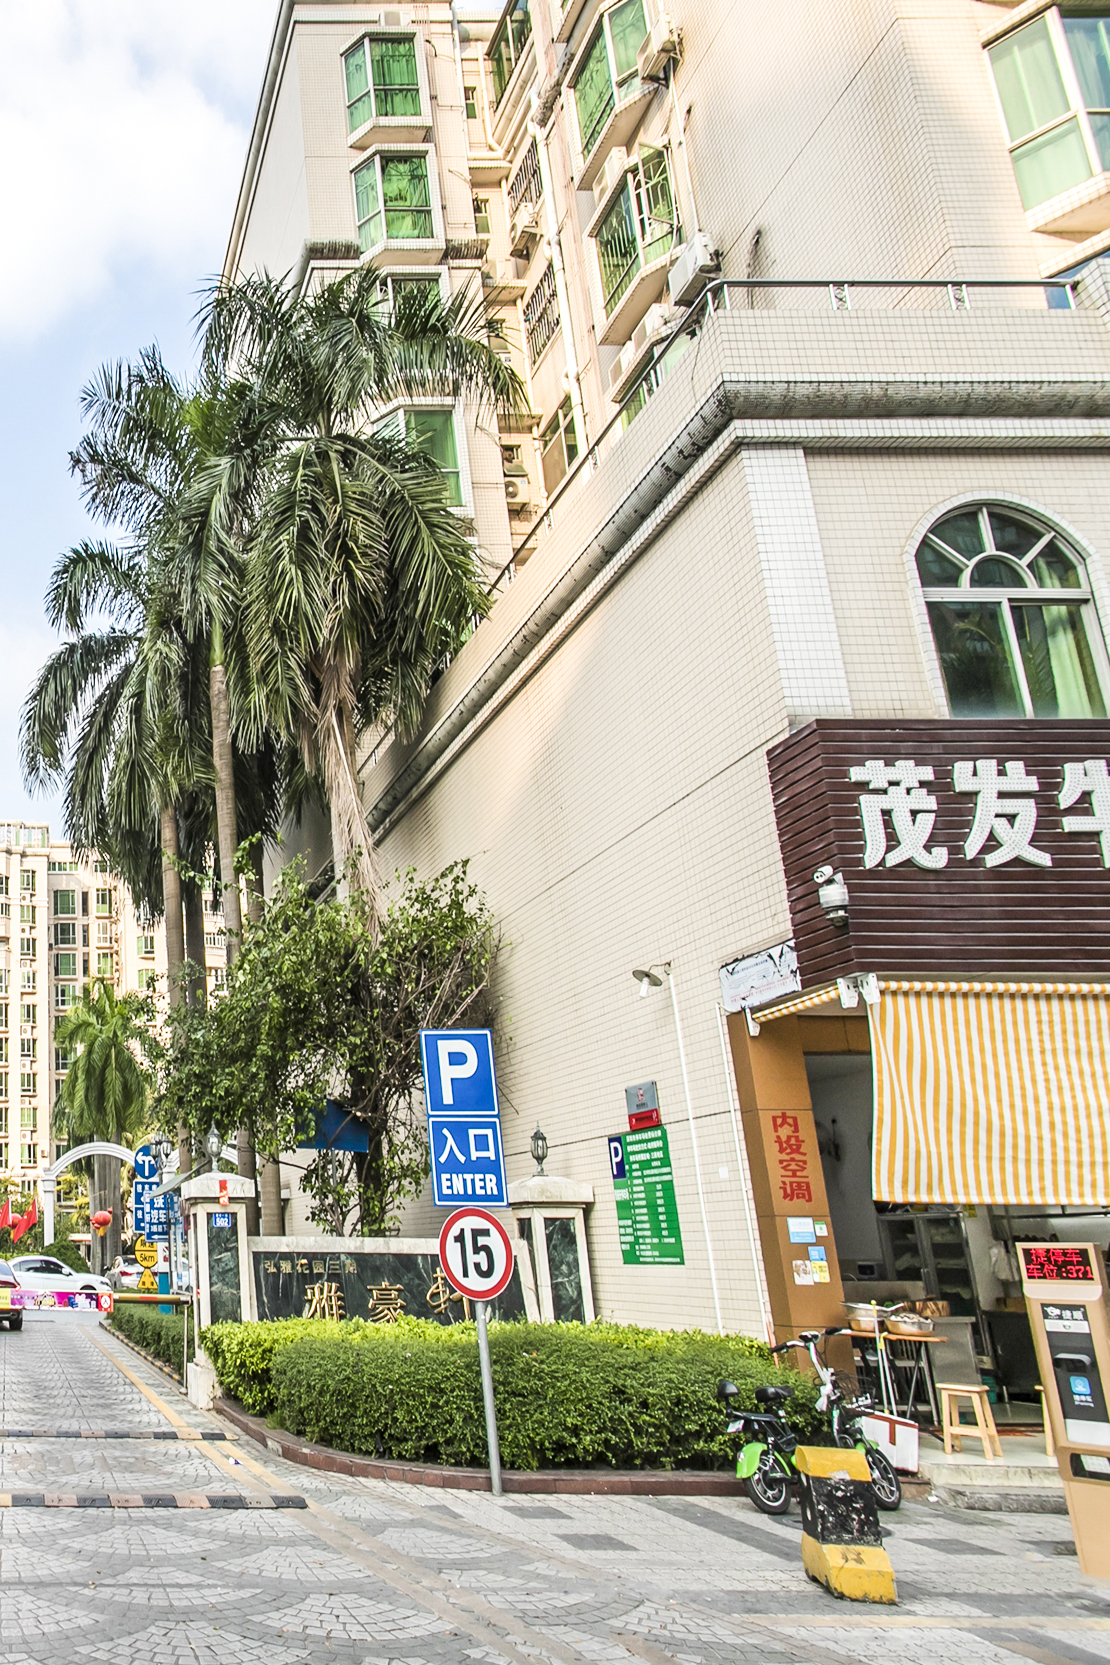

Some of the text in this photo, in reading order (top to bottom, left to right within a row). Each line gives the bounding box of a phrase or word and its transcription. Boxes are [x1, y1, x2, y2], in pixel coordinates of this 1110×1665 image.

[849, 759, 1110, 870] 茂发牛
[437, 1039, 478, 1105] P
[438, 1128, 496, 1164] 入口
[610, 1141, 623, 1175] P
[772, 1112, 813, 1203] 内设空调
[441, 1173, 499, 1196] ENTER
[215, 1217, 229, 1226] 502
[139, 1253, 155, 1263] 5km
[264, 1260, 358, 1274] 弘雅花园三期
[453, 1228, 495, 1279] 15
[1029, 1248, 1083, 1265] 捷停车
[1026, 1264, 1095, 1280] 车位:371
